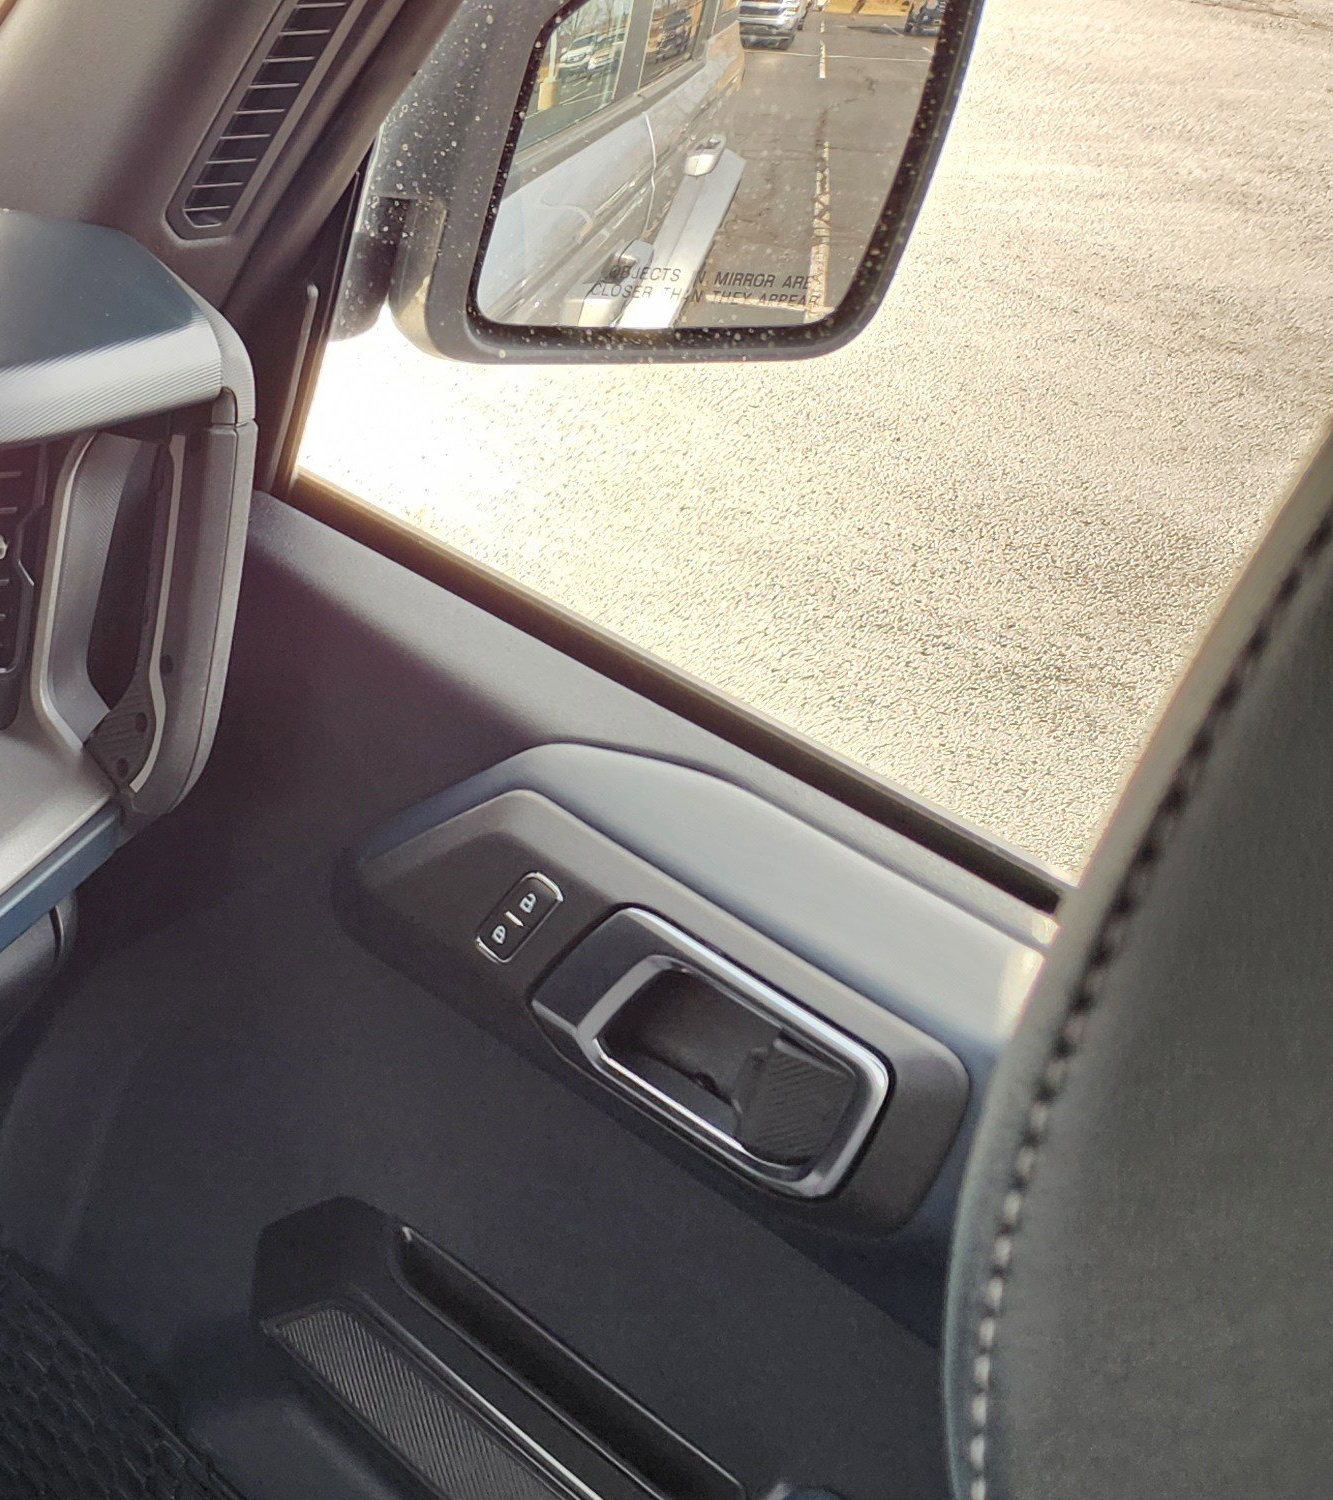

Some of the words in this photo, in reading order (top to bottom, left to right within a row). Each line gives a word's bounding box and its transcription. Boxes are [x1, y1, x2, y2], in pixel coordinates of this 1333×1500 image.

[609, 264, 681, 282] OBJECTS
[714, 271, 776, 288] MIRROR
[781, 275, 813, 290] ARE
[590, 280, 653, 298] CLOSER
[662, 287, 703, 302] THN
[713, 290, 752, 305] THEY
[758, 293, 820, 307] APPEAR
